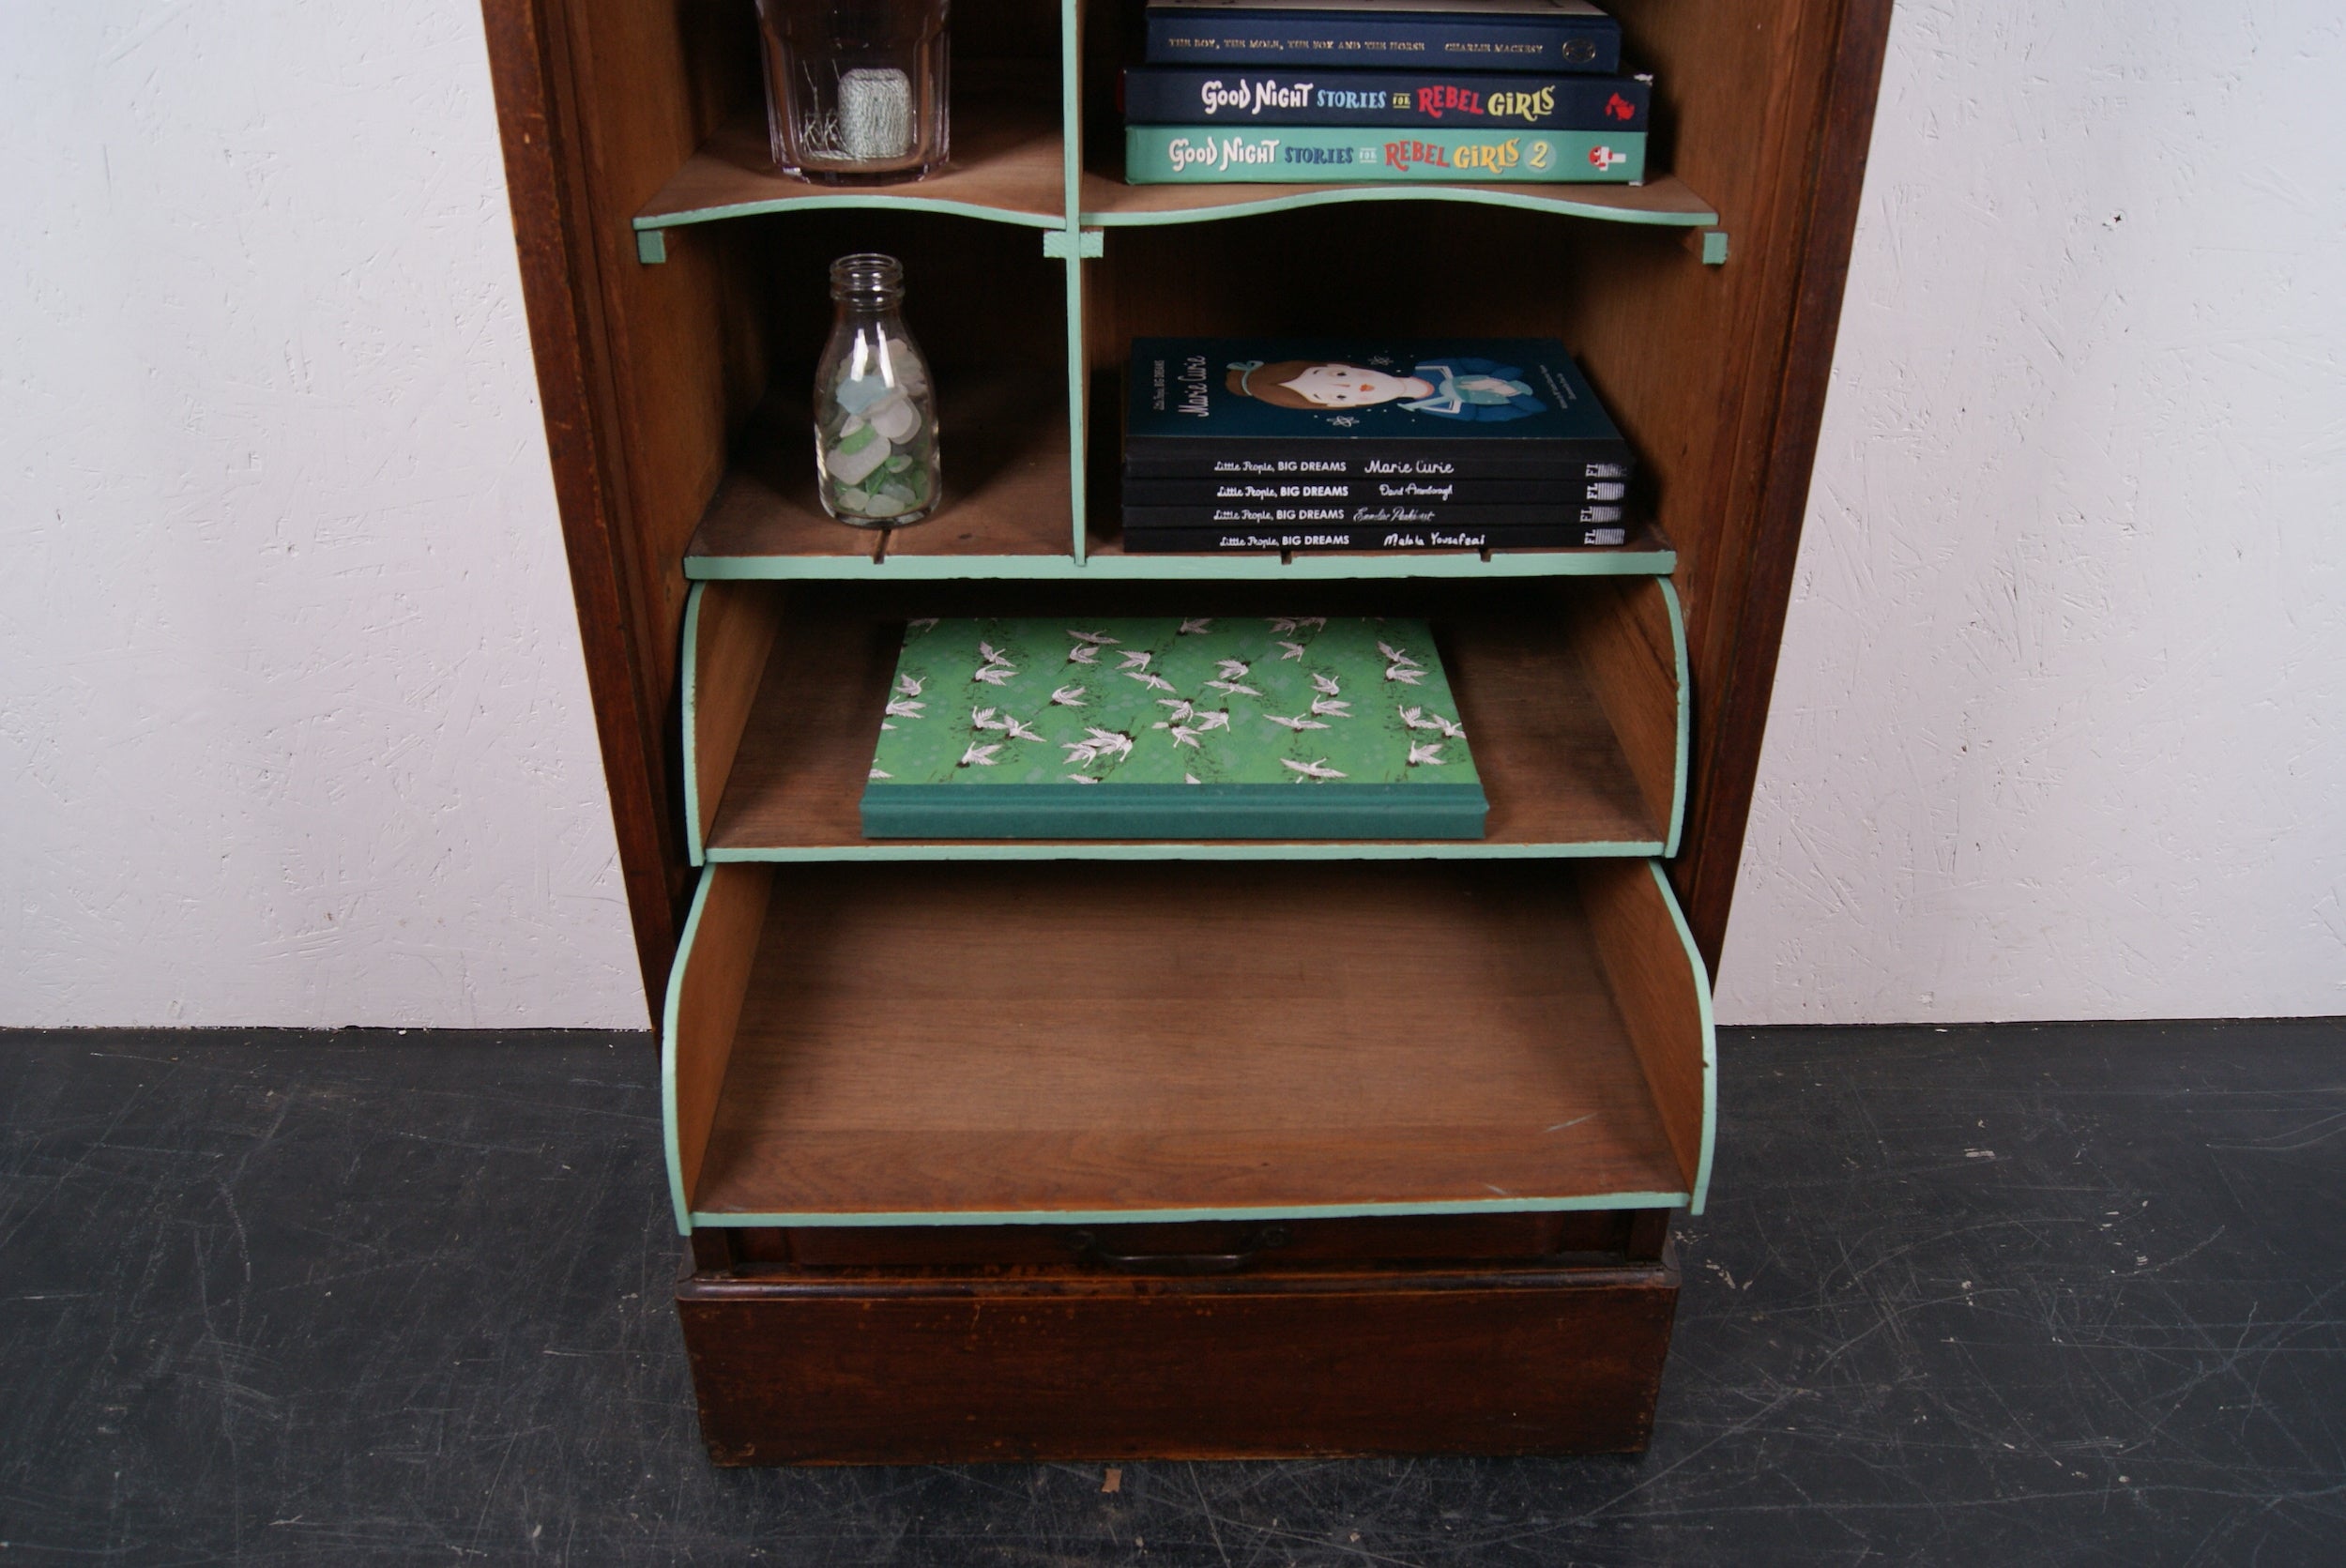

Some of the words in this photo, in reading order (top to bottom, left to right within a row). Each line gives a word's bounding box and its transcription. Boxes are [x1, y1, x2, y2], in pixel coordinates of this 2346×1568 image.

[1317, 89, 1387, 109] STORIES
[1416, 84, 1485, 118] REBEL
[1284, 146, 1353, 164] STORIES
[1384, 140, 1450, 172] REBEL
[1529, 141, 1548, 168] 2
[1177, 355, 1207, 382] Curie
[1178, 383, 1210, 417] Marie
[1214, 461, 1241, 471] Little
[1278, 461, 1297, 471] BIG
[1301, 461, 1347, 471] DREAMS
[1364, 460, 1413, 474] Marie
[1416, 460, 1455, 474] Curie
[1216, 486, 1243, 496] Little
[1280, 486, 1300, 496] BIG
[1302, 486, 1348, 496] DREAMS
[1213, 510, 1241, 520] Little
[1276, 510, 1296, 520] BIG
[1299, 510, 1344, 520] DREAMS
[1220, 536, 1245, 546] Little
[1282, 536, 1301, 546] BIG
[1303, 536, 1349, 546] DREAMS
